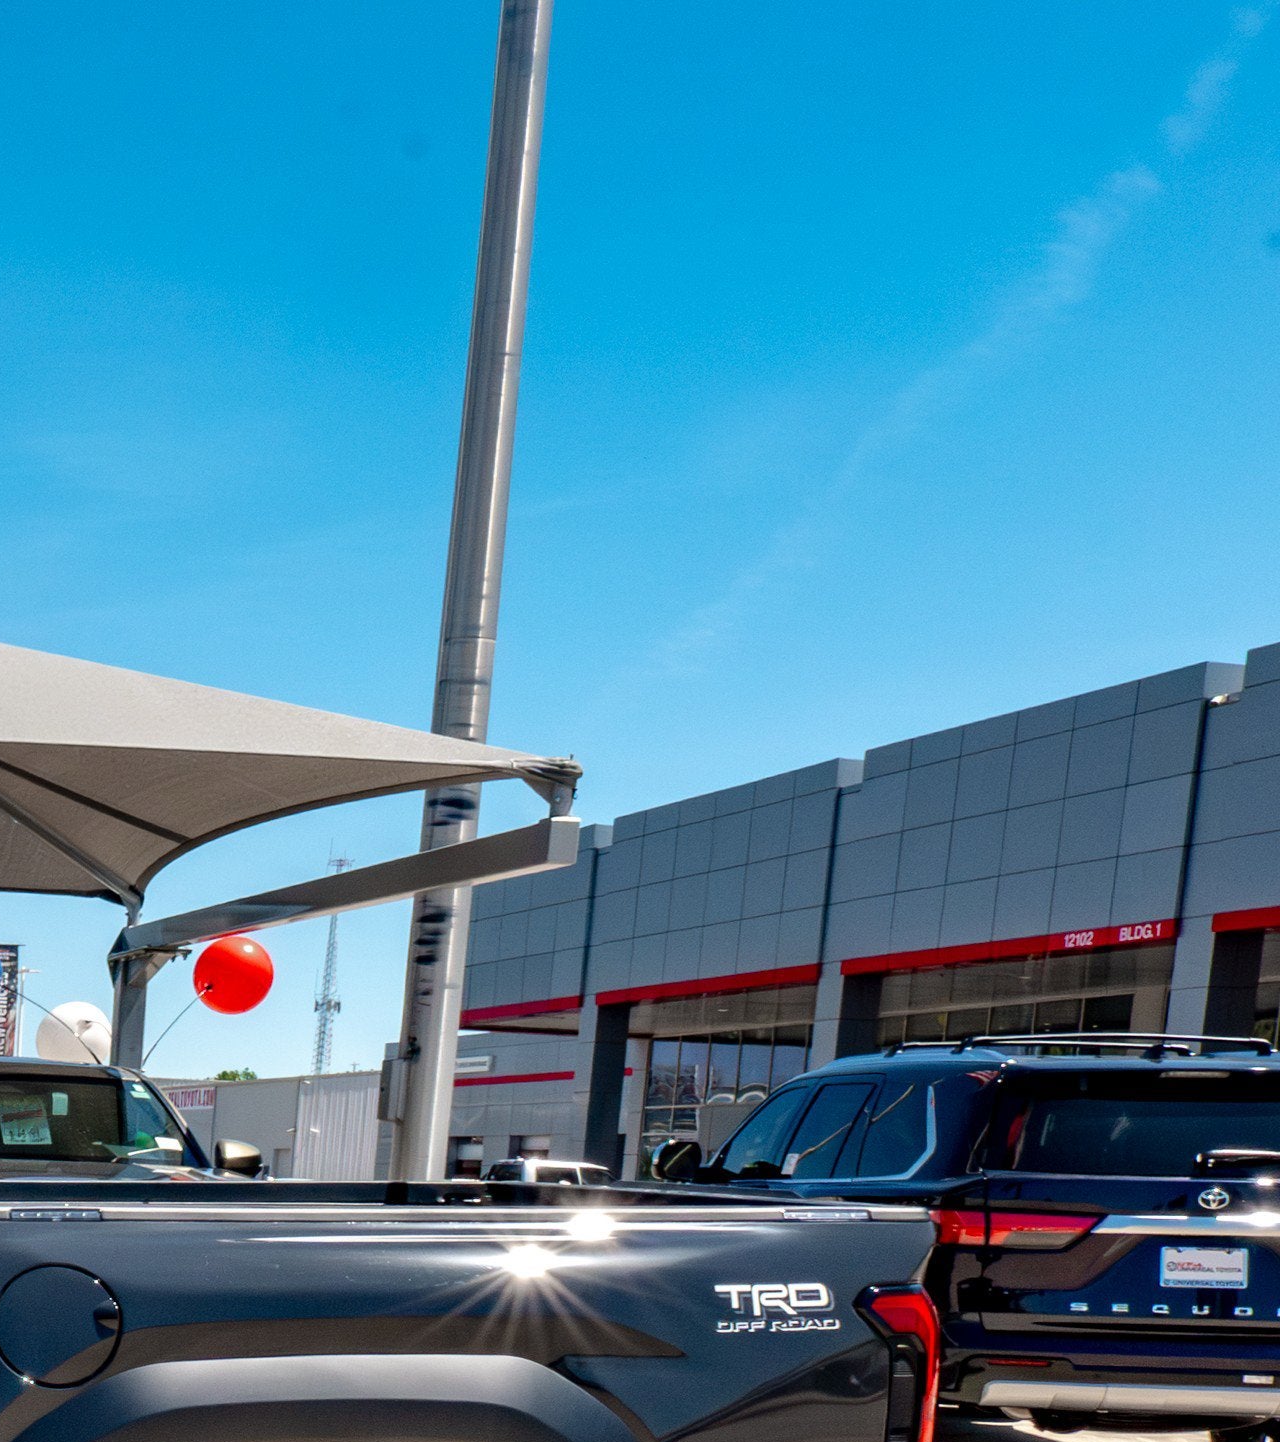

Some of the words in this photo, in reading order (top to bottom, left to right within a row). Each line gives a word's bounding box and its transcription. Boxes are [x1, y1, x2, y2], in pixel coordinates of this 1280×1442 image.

[1155, 923, 1162, 937] 1
[1064, 931, 1094, 948] 12102
[714, 1283, 830, 1317] TRD
[1069, 1302, 1280, 1318] SEQUO
[716, 1320, 767, 1333] OFF
[769, 1318, 841, 1333] ROAD
